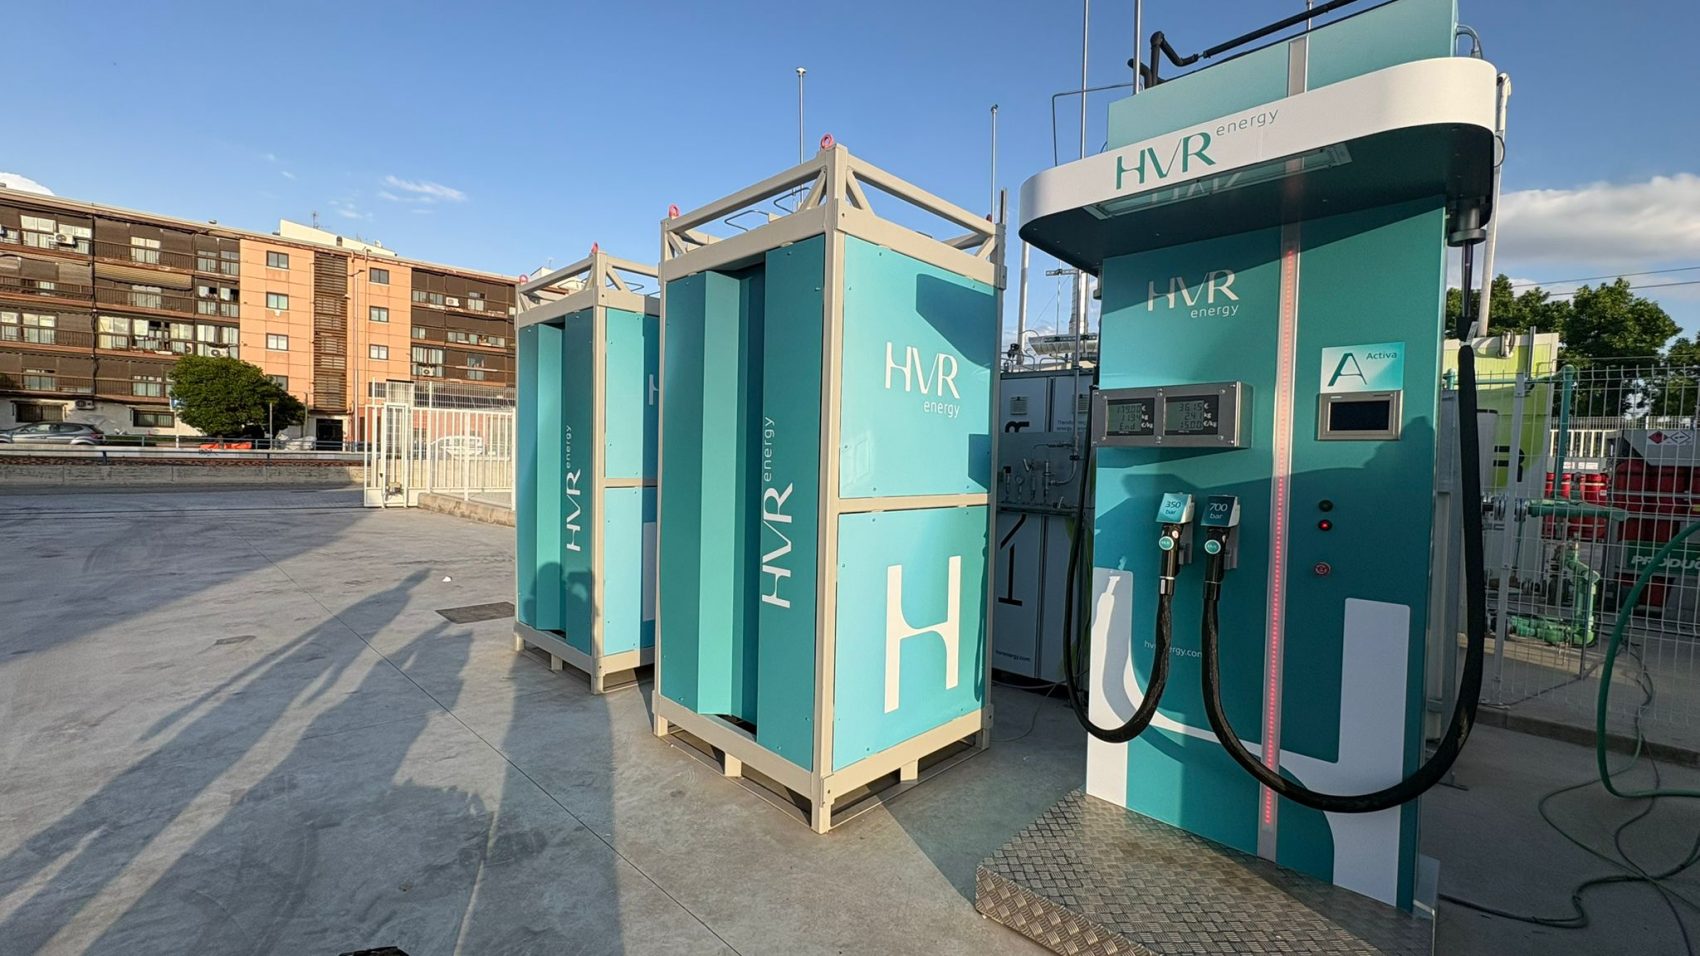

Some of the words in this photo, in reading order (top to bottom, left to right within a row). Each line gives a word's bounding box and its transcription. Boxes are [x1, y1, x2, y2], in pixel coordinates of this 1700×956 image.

[1116, 132, 1216, 190] HVR
[1216, 109, 1279, 137] energy
[1147, 269, 1239, 311] HVR
[1190, 304, 1239, 318] energy
[885, 341, 960, 399] HVR
[1327, 352, 1367, 387] A
[1366, 352, 1397, 360] Activa
[923, 400, 960, 418] energy
[763, 416, 775, 482] energy
[566, 468, 581, 552] HVR
[1166, 501, 1182, 509] 350
[1209, 503, 1228, 512] 700
[761, 482, 793, 609] HVR
[884, 555, 961, 714] H
